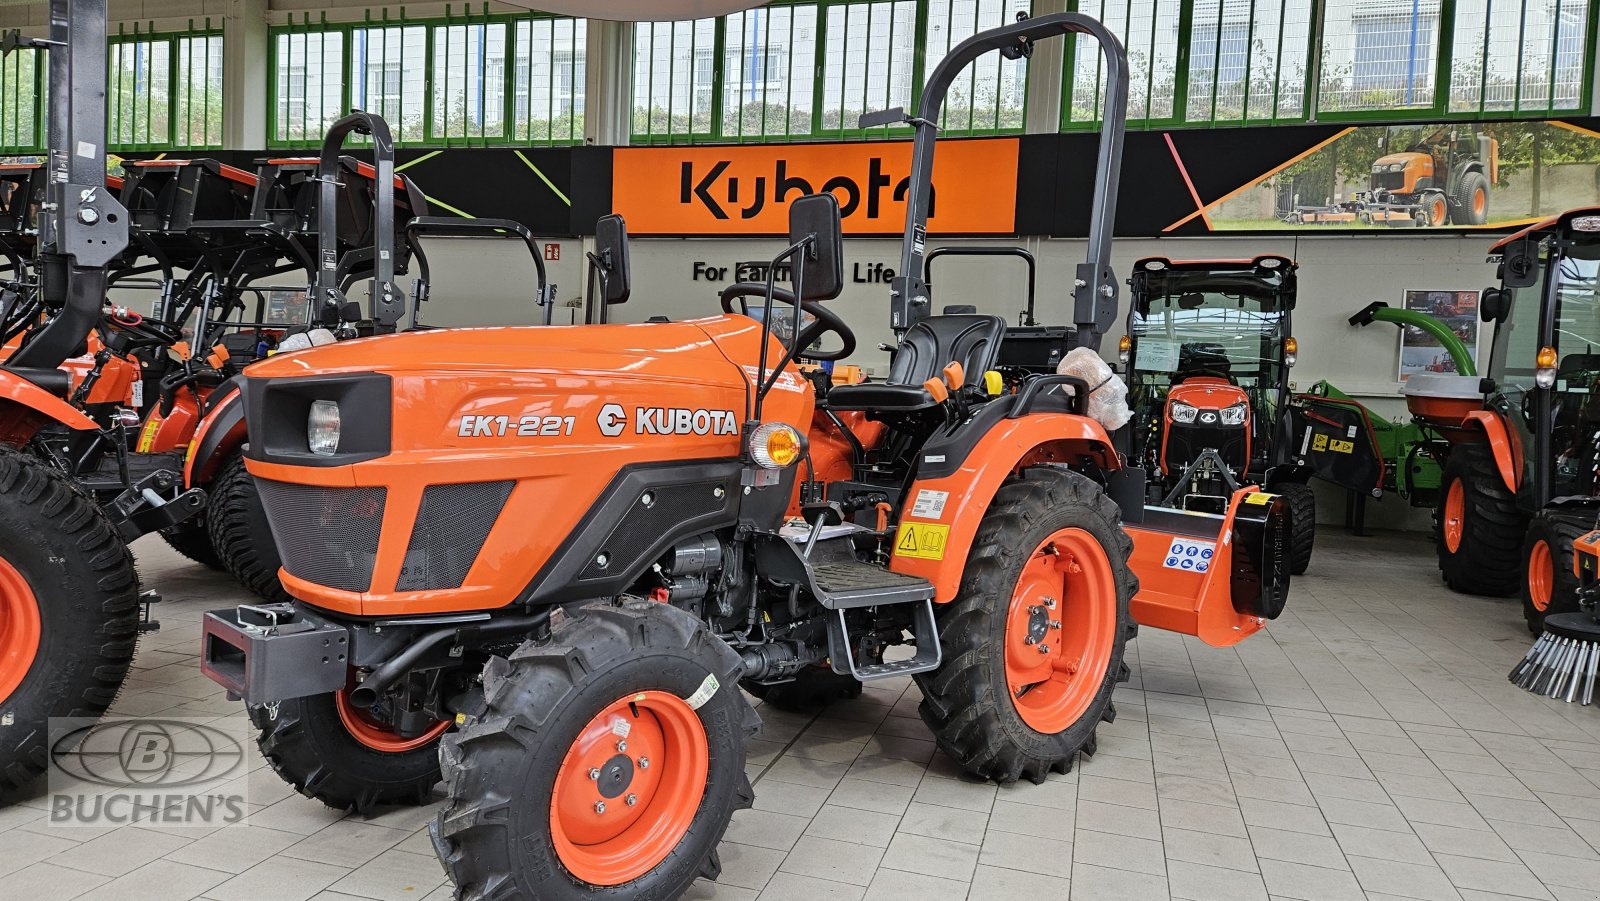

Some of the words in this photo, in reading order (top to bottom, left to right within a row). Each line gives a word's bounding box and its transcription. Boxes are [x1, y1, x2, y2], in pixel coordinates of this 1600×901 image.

[692, 261, 728, 281] For
[853, 262, 895, 283] Life
[458, 415, 576, 437] EK1-221
[635, 406, 739, 436] KUBOTA
